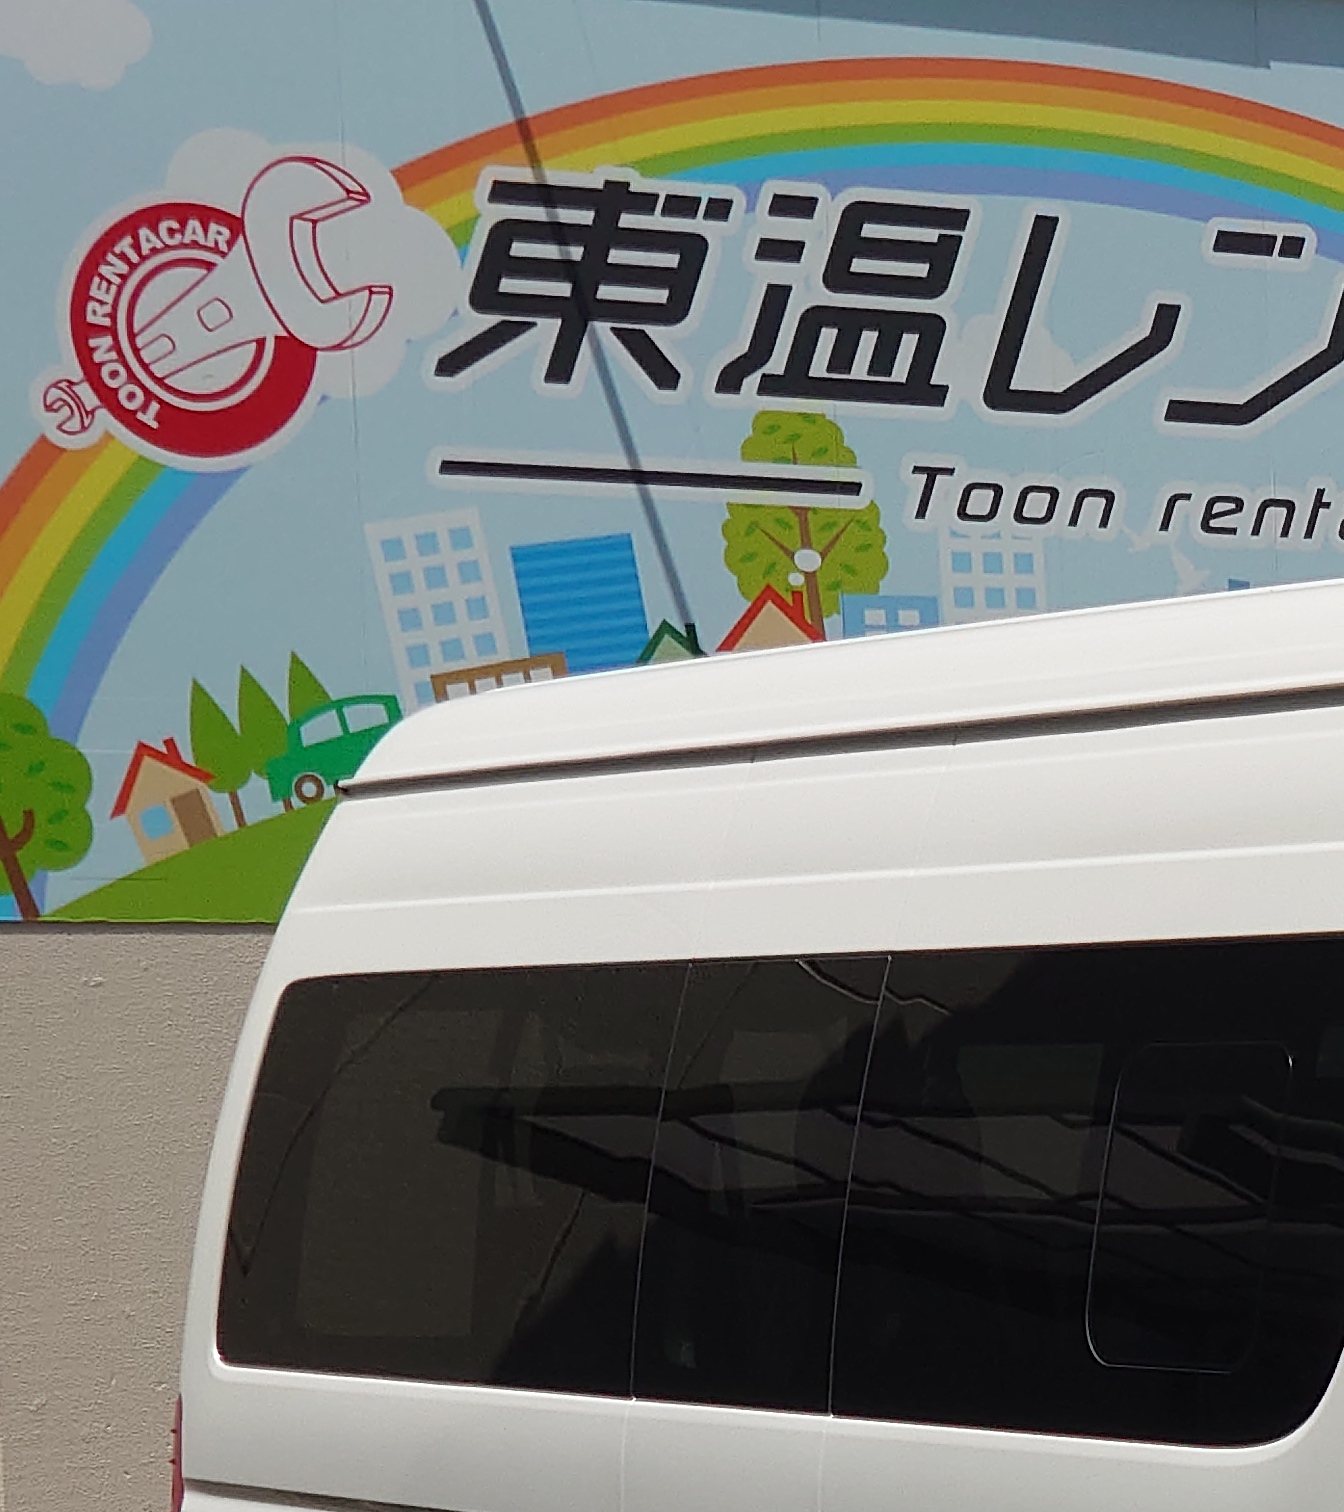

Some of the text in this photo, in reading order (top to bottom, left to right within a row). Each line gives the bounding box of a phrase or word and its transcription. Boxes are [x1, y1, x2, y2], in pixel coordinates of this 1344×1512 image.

[86, 218, 231, 430] TOON RENTACAR
[912, 466, 1116, 529] Toon
